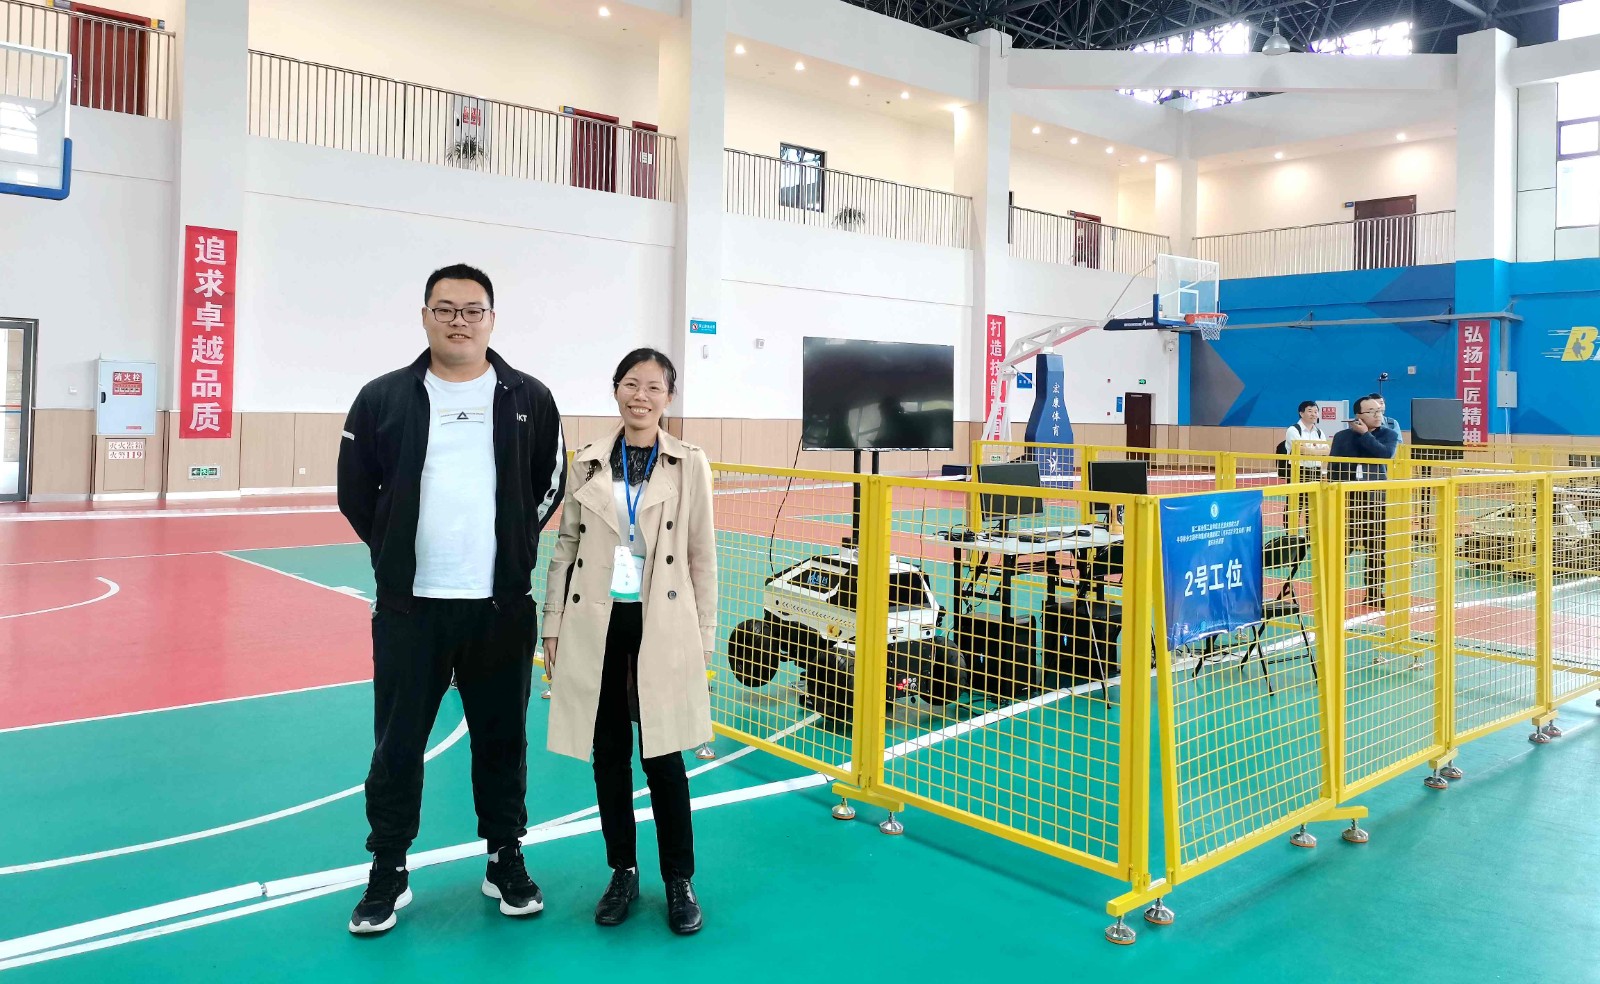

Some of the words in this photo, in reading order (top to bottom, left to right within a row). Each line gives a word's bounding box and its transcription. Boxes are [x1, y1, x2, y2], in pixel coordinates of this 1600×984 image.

[189, 236, 227, 431] 追求卓越品质
[114, 373, 141, 382] 消火栓
[1463, 326, 1483, 444] 弘扬工匠精神
[1052, 382, 1061, 437] 宏康体育
[1184, 558, 1243, 597] 2号工位
